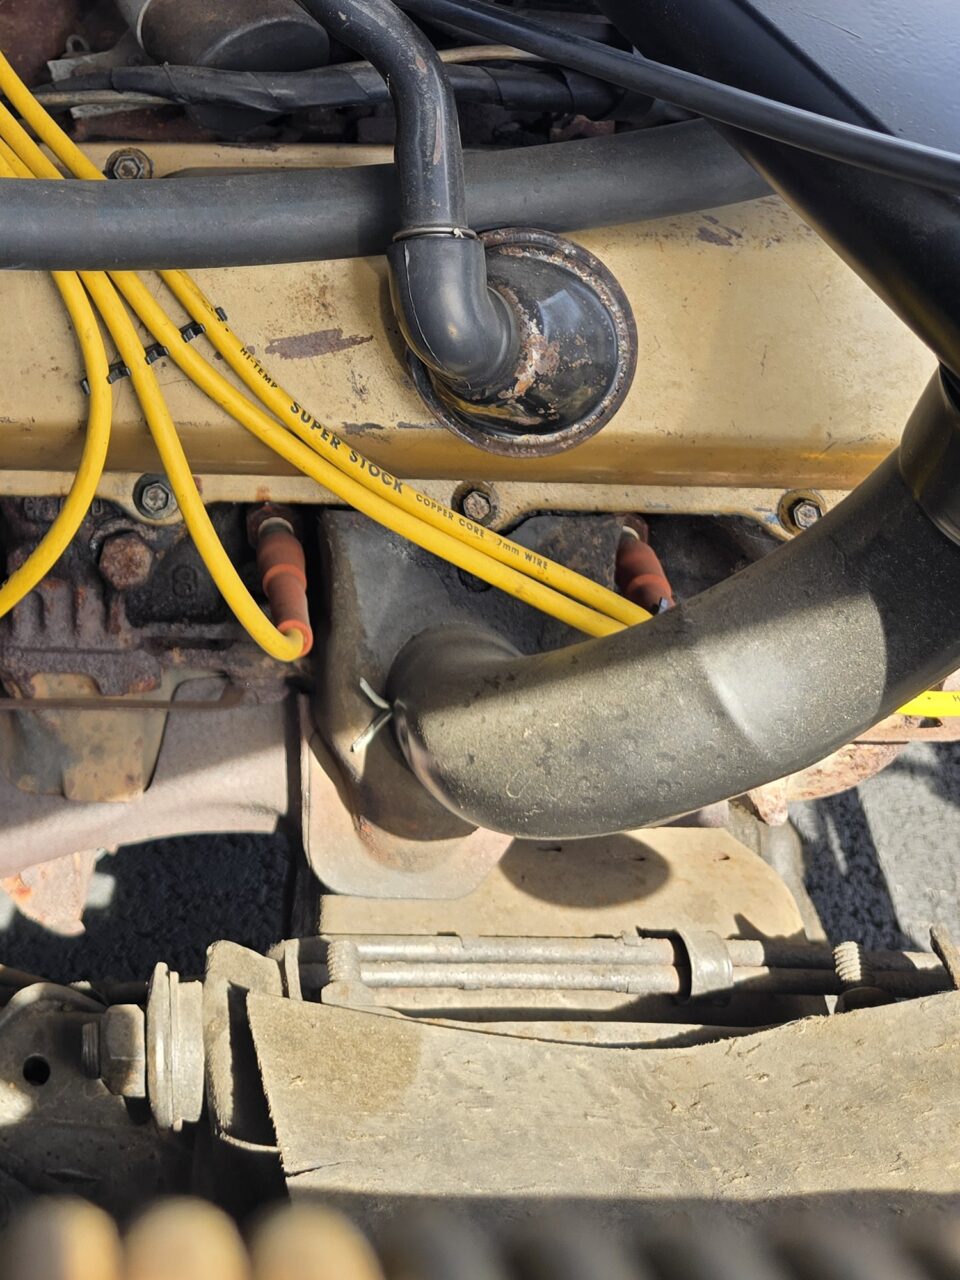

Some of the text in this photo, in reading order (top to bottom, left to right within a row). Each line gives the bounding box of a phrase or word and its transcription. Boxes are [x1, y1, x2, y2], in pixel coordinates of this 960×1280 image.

[239, 346, 548, 570] HI-TEMP SUPER STOCK COPPER CORE 7mm WIRE
